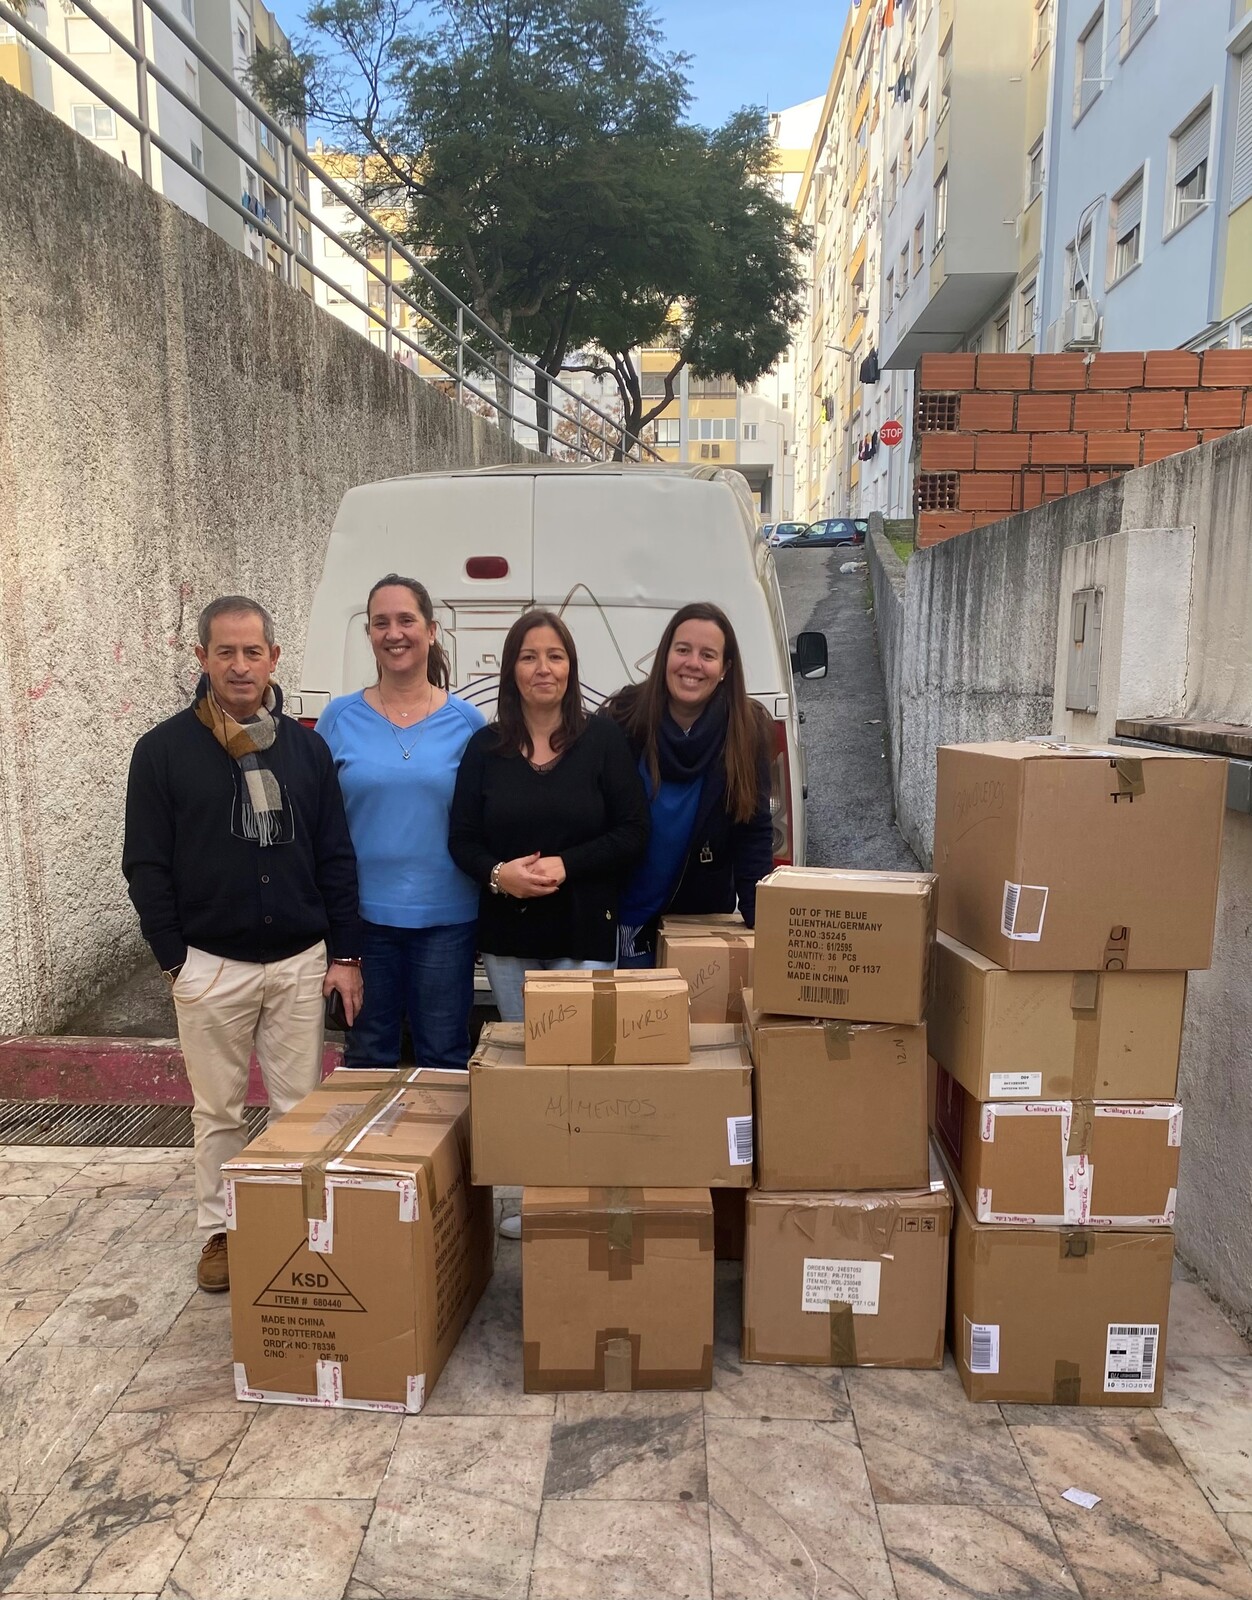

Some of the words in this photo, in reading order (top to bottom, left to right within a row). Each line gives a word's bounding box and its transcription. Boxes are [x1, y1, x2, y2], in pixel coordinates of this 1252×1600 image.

[880, 428, 903, 438] STOP
[789, 908, 807, 916] OUT
[810, 909, 821, 917] OF
[825, 910, 841, 918] THE
[845, 911, 868, 920] BLUE
[789, 918, 883, 932] LILIENTHAL/GERMANY
[827, 942, 853, 952] 61/2595
[788, 950, 825, 961] QUANTITY:
[827, 953, 837, 961] 36
[842, 953, 857, 961] PCS
[849, 965, 860, 973] OF
[862, 965, 881, 974] 1137
[787, 971, 811, 981] MADE
[812, 973, 821, 981] IN
[822, 974, 849, 983] CHINA
[622, 1008, 669, 1039] LIVROS
[545, 1096, 657, 1119] ALIMENTOS
[291, 1272, 329, 1288] KSD
[274, 1295, 299, 1305] ITEM
[301, 1297, 308, 1306] #
[313, 1298, 342, 1308] 680440
[261, 1315, 286, 1325] MADE
[288, 1317, 296, 1325] IN
[298, 1317, 326, 1327] CHINA
[262, 1327, 280, 1336] POD
[282, 1329, 336, 1339] ROTTERDAM
[263, 1339, 293, 1349] ORDER
[295, 1342, 310, 1350] NO:
[312, 1343, 336, 1351] 78336
[264, 1350, 287, 1359] C/NO:
[320, 1353, 331, 1361] OF
[335, 1354, 349, 1362] 700
